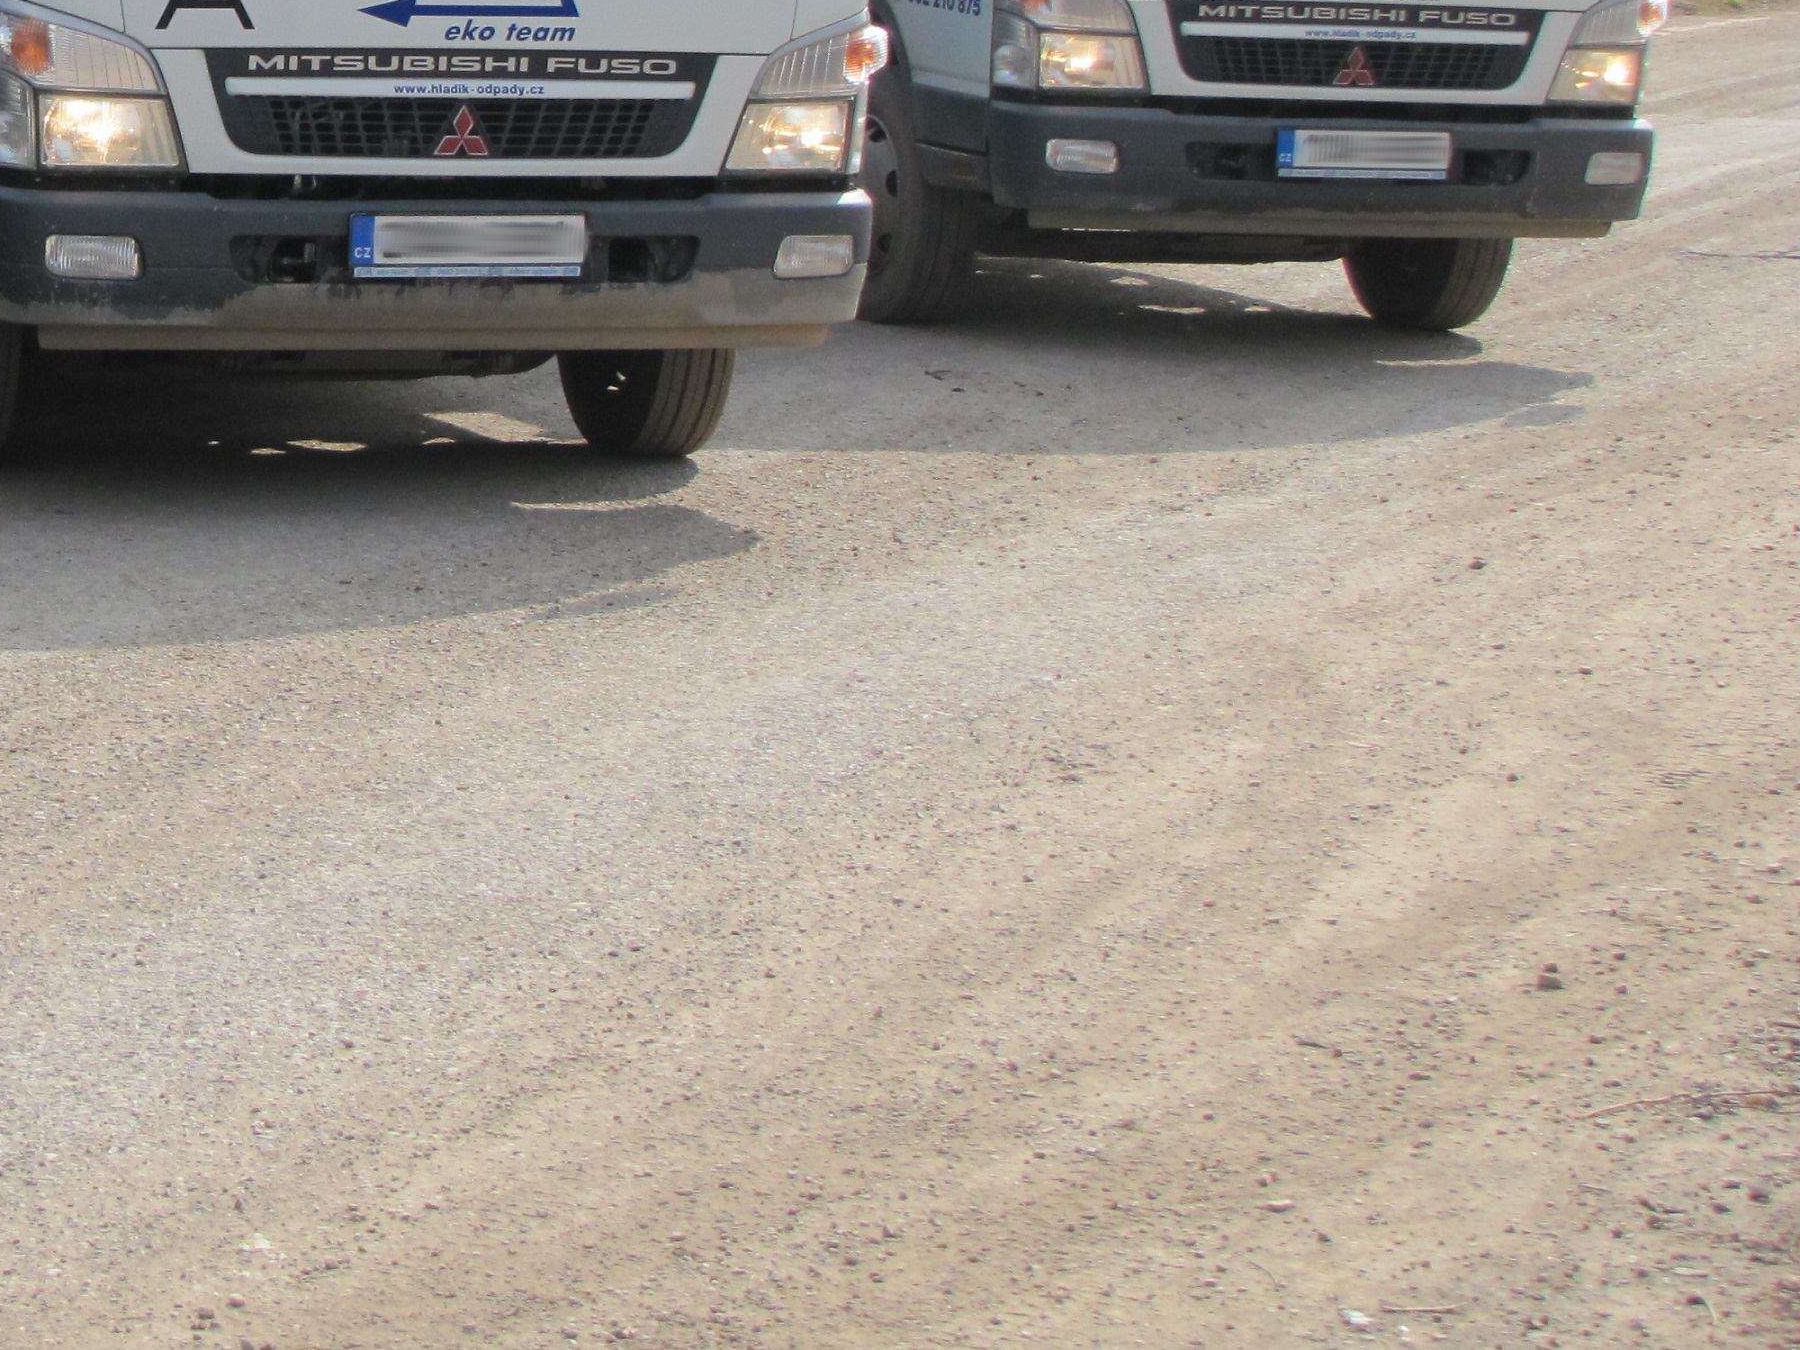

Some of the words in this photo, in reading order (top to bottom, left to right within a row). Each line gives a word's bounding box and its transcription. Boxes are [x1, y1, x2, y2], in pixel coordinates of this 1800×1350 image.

[1198, 4, 1407, 23] MITSUBISHI
[1419, 8, 1517, 27] FUSO
[444, 19, 496, 41] eko
[505, 23, 576, 42] team
[247, 54, 529, 75] MITSUBISHI
[545, 58, 677, 76] FUSO
[393, 83, 545, 98] www.hladik-odpady.cz
[1278, 153, 1292, 162] CZ
[354, 247, 371, 259] CZ
